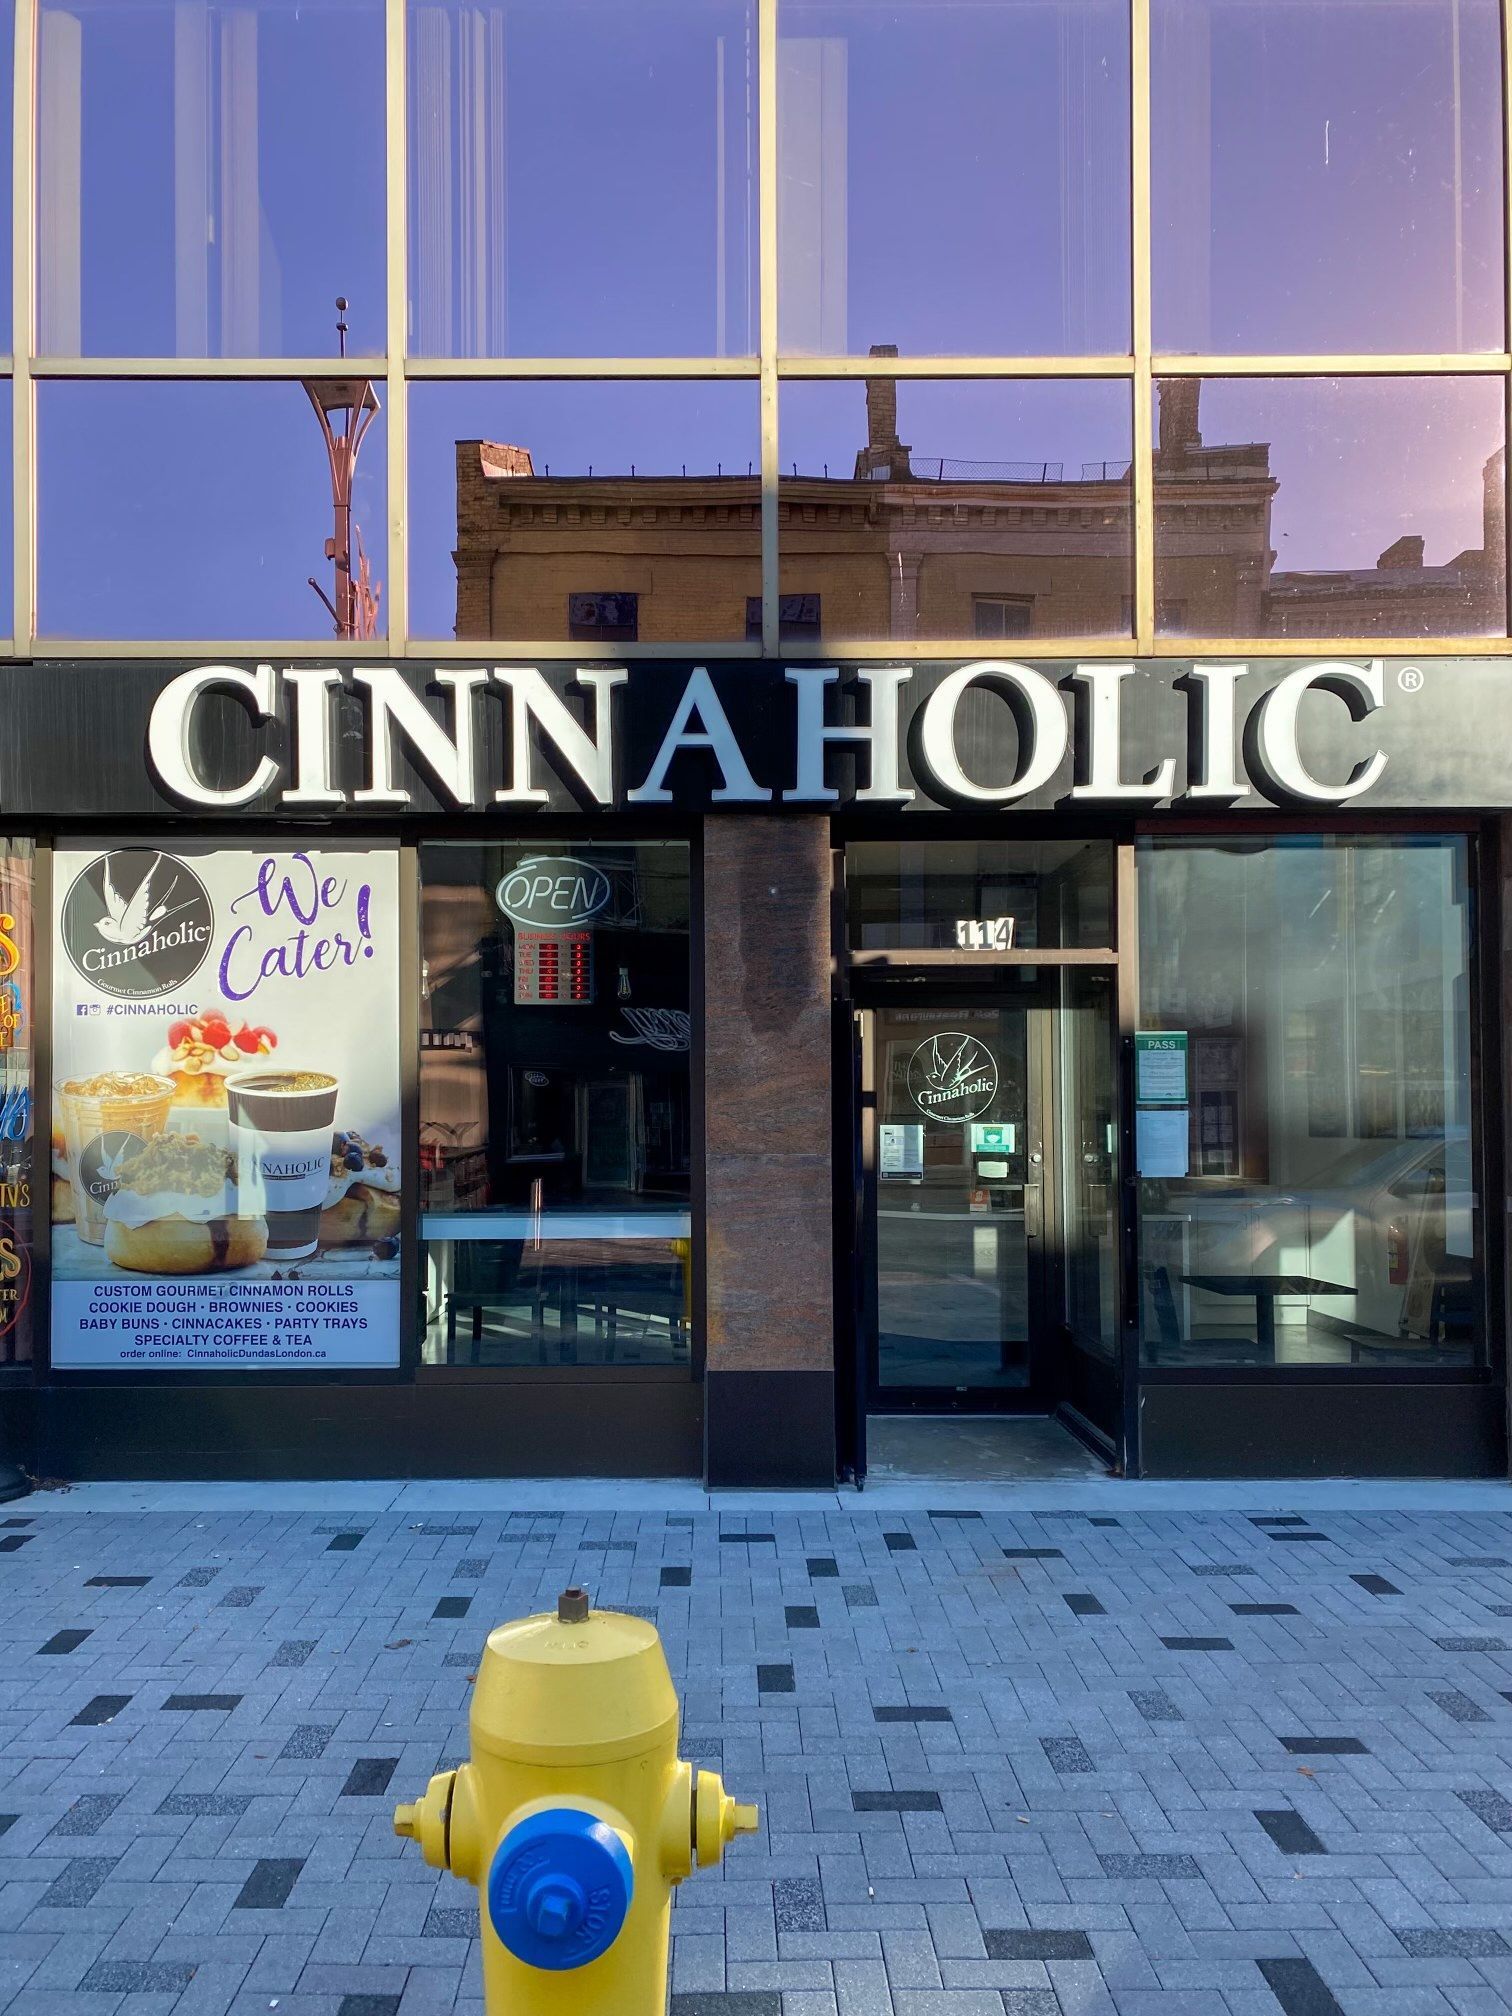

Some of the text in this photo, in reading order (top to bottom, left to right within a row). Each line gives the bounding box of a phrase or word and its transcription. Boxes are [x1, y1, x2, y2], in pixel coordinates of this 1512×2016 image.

[148, 659, 1389, 806] CINNAHOLIC
[230, 853, 347, 925] We
[505, 876, 599, 910] OPEN
[219, 884, 374, 1001] Cater!
[959, 919, 1012, 949] 114
[82, 920, 206, 971] Cinnaholic
[97, 978, 178, 995] Gourmet Cinnamon Rolls
[106, 1004, 198, 1015] #CINNAHOLIC
[1148, 1041, 1175, 1049] PASS
[918, 1077, 993, 1105] Cinnaholic
[94, 1285, 354, 1297] CUSTOM GOURMET CINNAMON ROLLS
[89, 1301, 359, 1313] COOKIE DOUGH BROWNIES COOKIES
[79, 1318, 368, 1330] BABY BUNS CINNACAKES PARTY TRAYS
[134, 1334, 313, 1346] SPECIALTY COFFEE & TEA
[120, 1349, 327, 1358] order online: CinnaholicDundasLondon.ca
